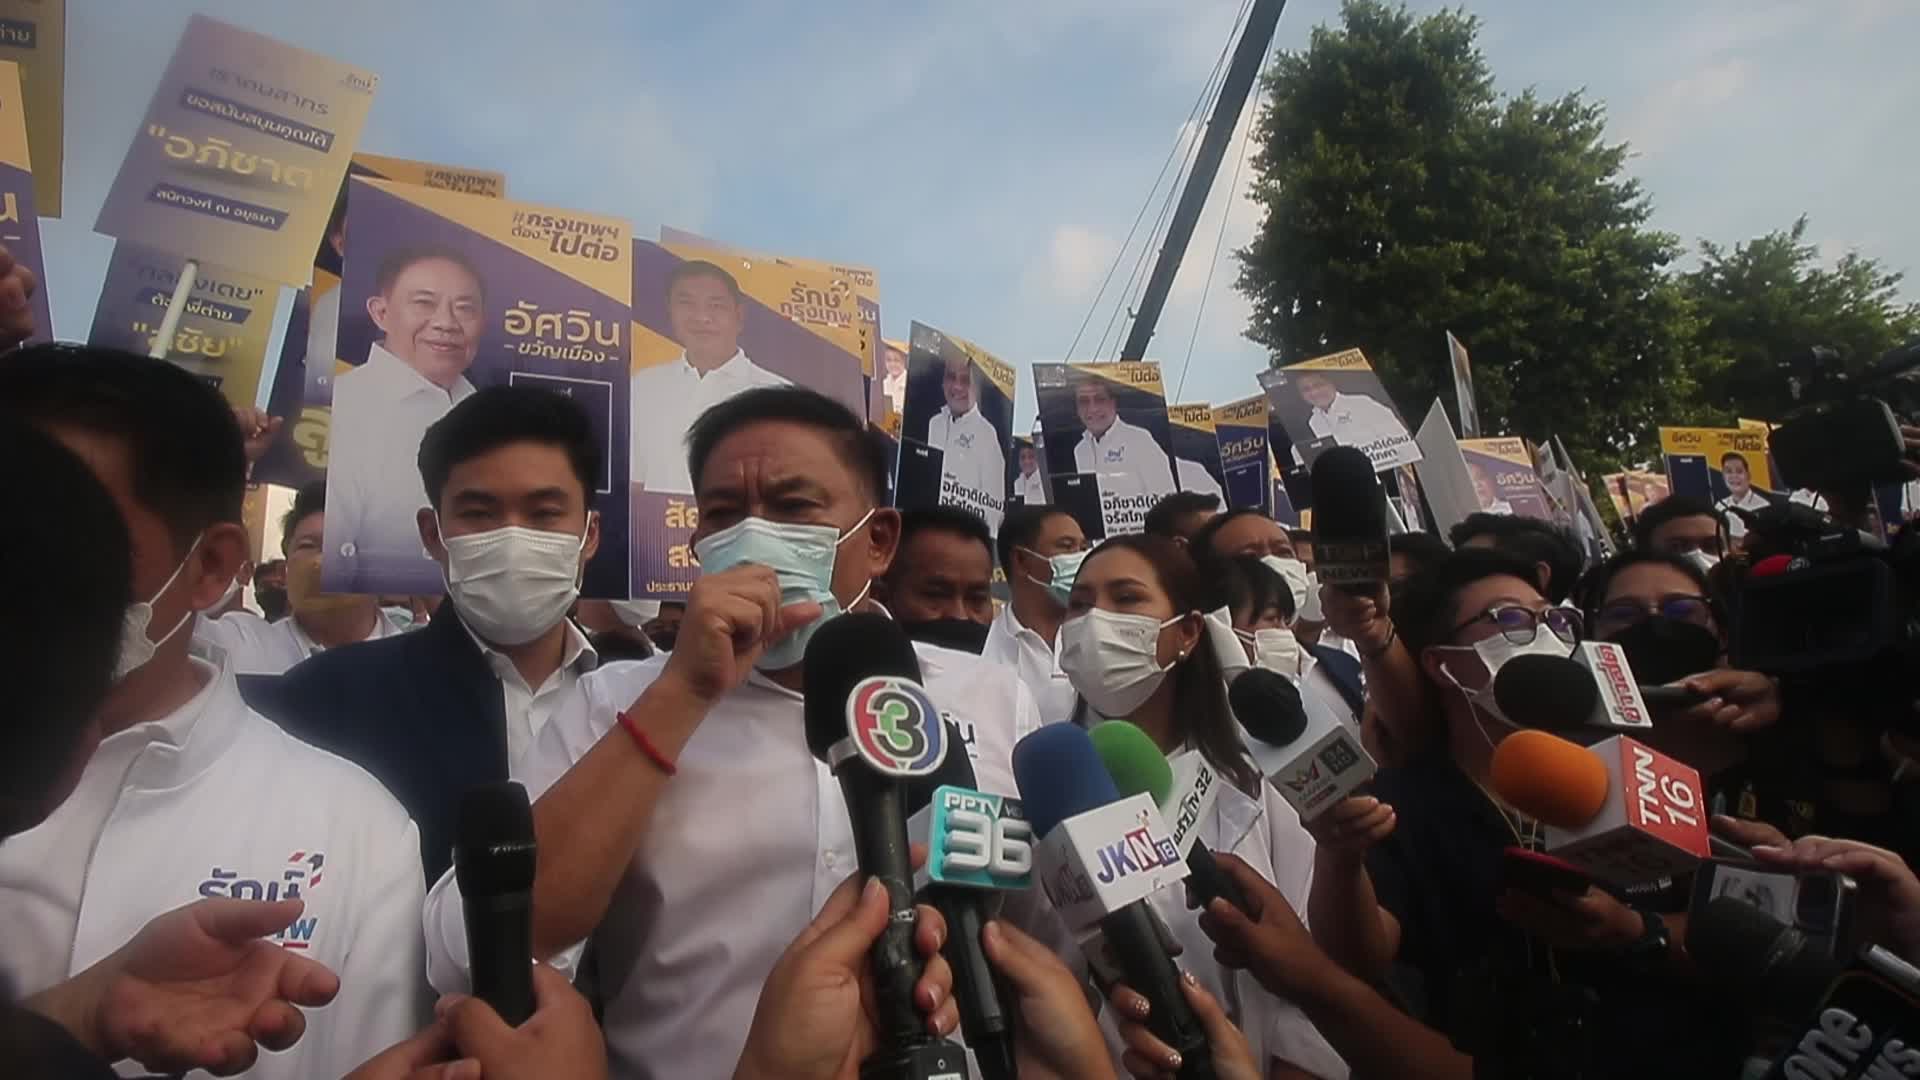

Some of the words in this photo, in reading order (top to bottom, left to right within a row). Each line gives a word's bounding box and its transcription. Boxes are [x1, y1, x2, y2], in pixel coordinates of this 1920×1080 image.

[503, 300, 621, 348] อัศวิน
[944, 791, 1004, 820] PPTV
[1194, 767, 1213, 797] 32
[1632, 745, 1663, 826] TNN
[1659, 774, 1698, 827] 16
[942, 808, 1033, 876] 36
